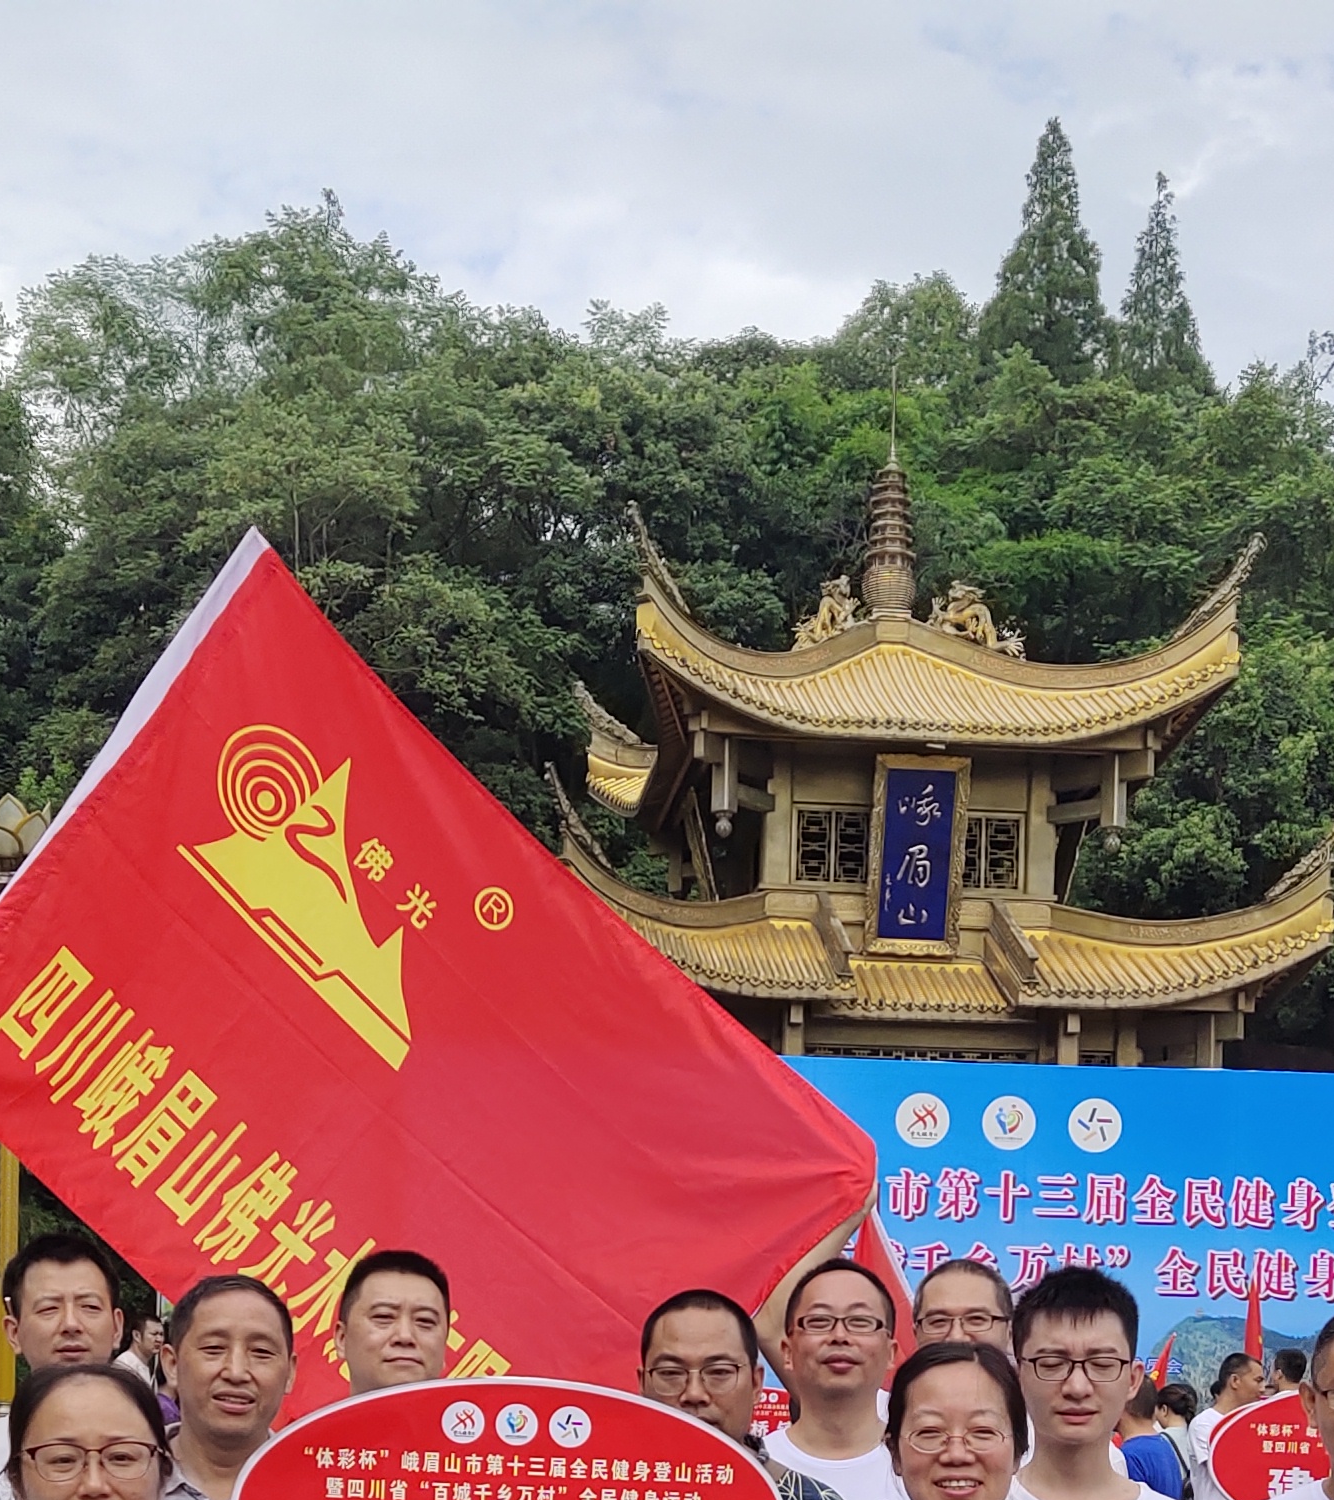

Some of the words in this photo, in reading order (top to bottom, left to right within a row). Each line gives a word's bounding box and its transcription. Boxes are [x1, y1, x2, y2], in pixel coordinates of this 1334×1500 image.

[353, 837, 437, 930] 佛光
[303, 1446, 734, 1486] “体彩杯”峨眉山市第十三届全民健身登山活动
